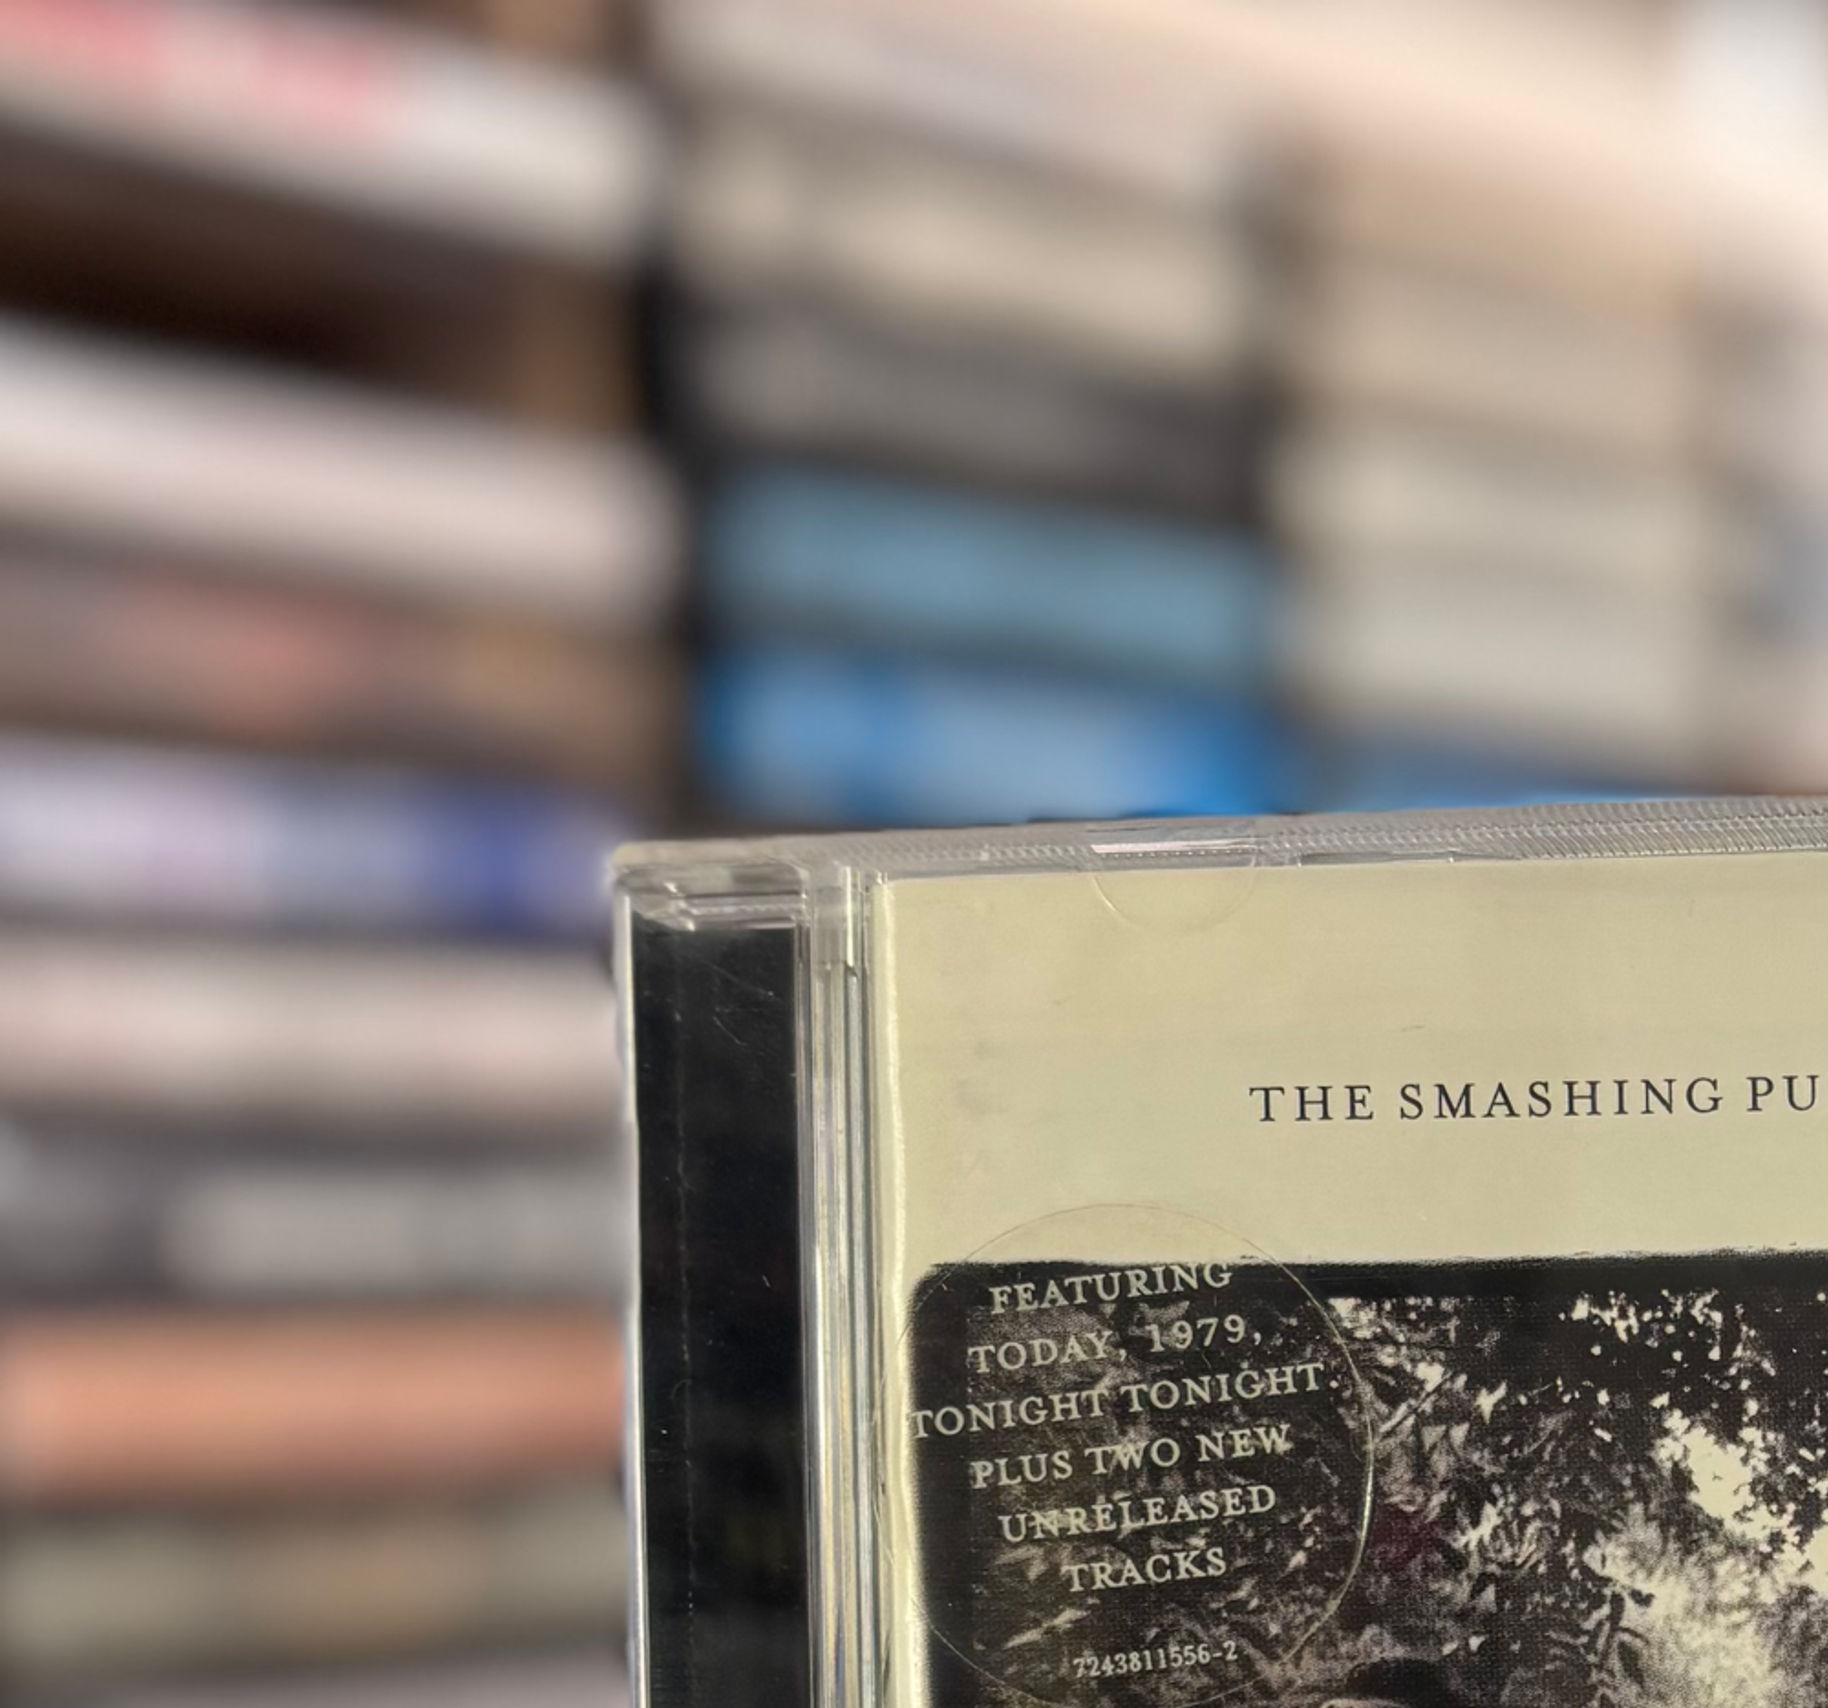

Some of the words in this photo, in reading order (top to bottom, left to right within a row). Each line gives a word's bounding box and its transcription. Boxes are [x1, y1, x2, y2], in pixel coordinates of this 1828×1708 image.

[1248, 1084, 1375, 1122] THE
[1399, 1076, 1724, 1120] SMASHING
[990, 1262, 1232, 1315] FEATURING
[967, 1329, 1128, 1374] TODAY,
[1148, 1313, 1263, 1354] 1979,
[908, 1390, 1109, 1440] TONIGHT
[969, 1450, 1074, 1490] PLUS
[1083, 1438, 1181, 1477] TWO
[1194, 1422, 1294, 1461] NEW
[998, 1483, 1277, 1544] UNRELEASED
[1061, 1546, 1228, 1594] TRACKS
[1072, 1640, 1239, 1679] 7243811556-2
